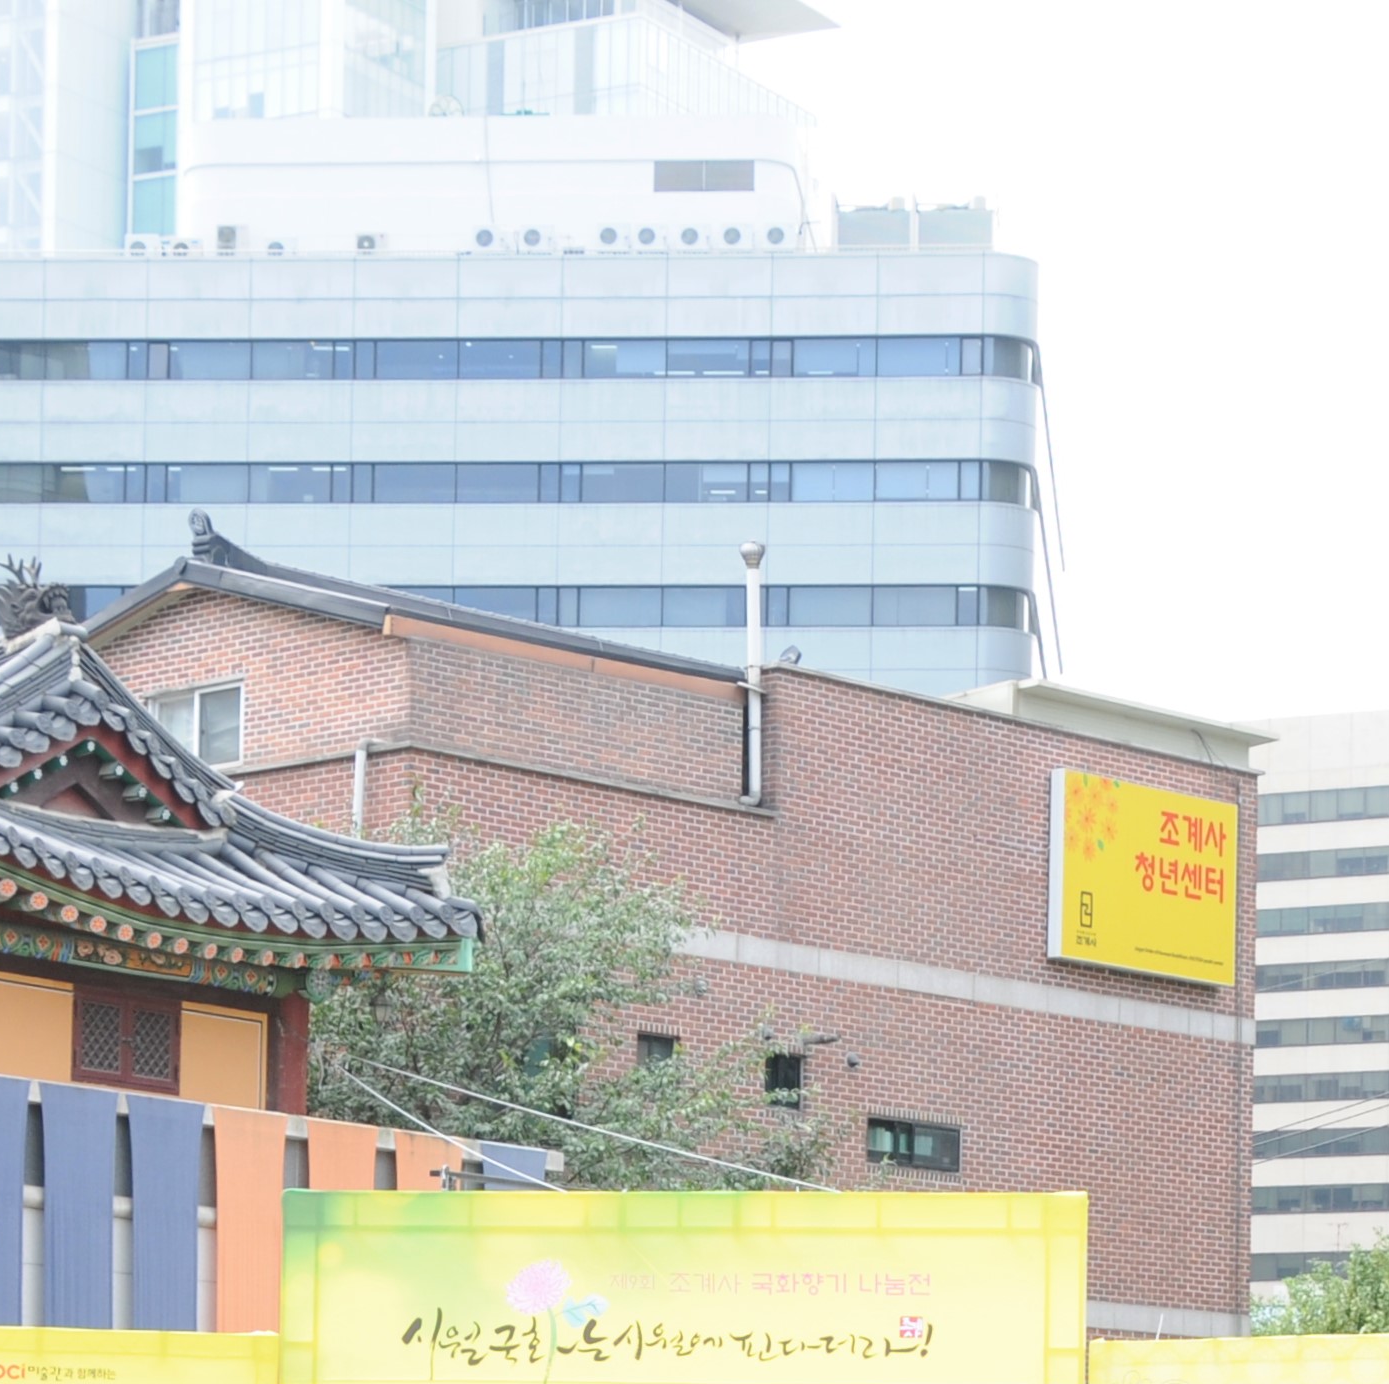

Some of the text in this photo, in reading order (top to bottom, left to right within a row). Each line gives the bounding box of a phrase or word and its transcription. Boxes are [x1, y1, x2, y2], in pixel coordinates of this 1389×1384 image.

[1160, 810, 1227, 858] 조계사
[1135, 852, 1225, 904] 청년센터
[669, 1273, 741, 1296] 조계사
[751, 1272, 847, 1296] 국화향기
[858, 1273, 932, 1297] 나눔전
